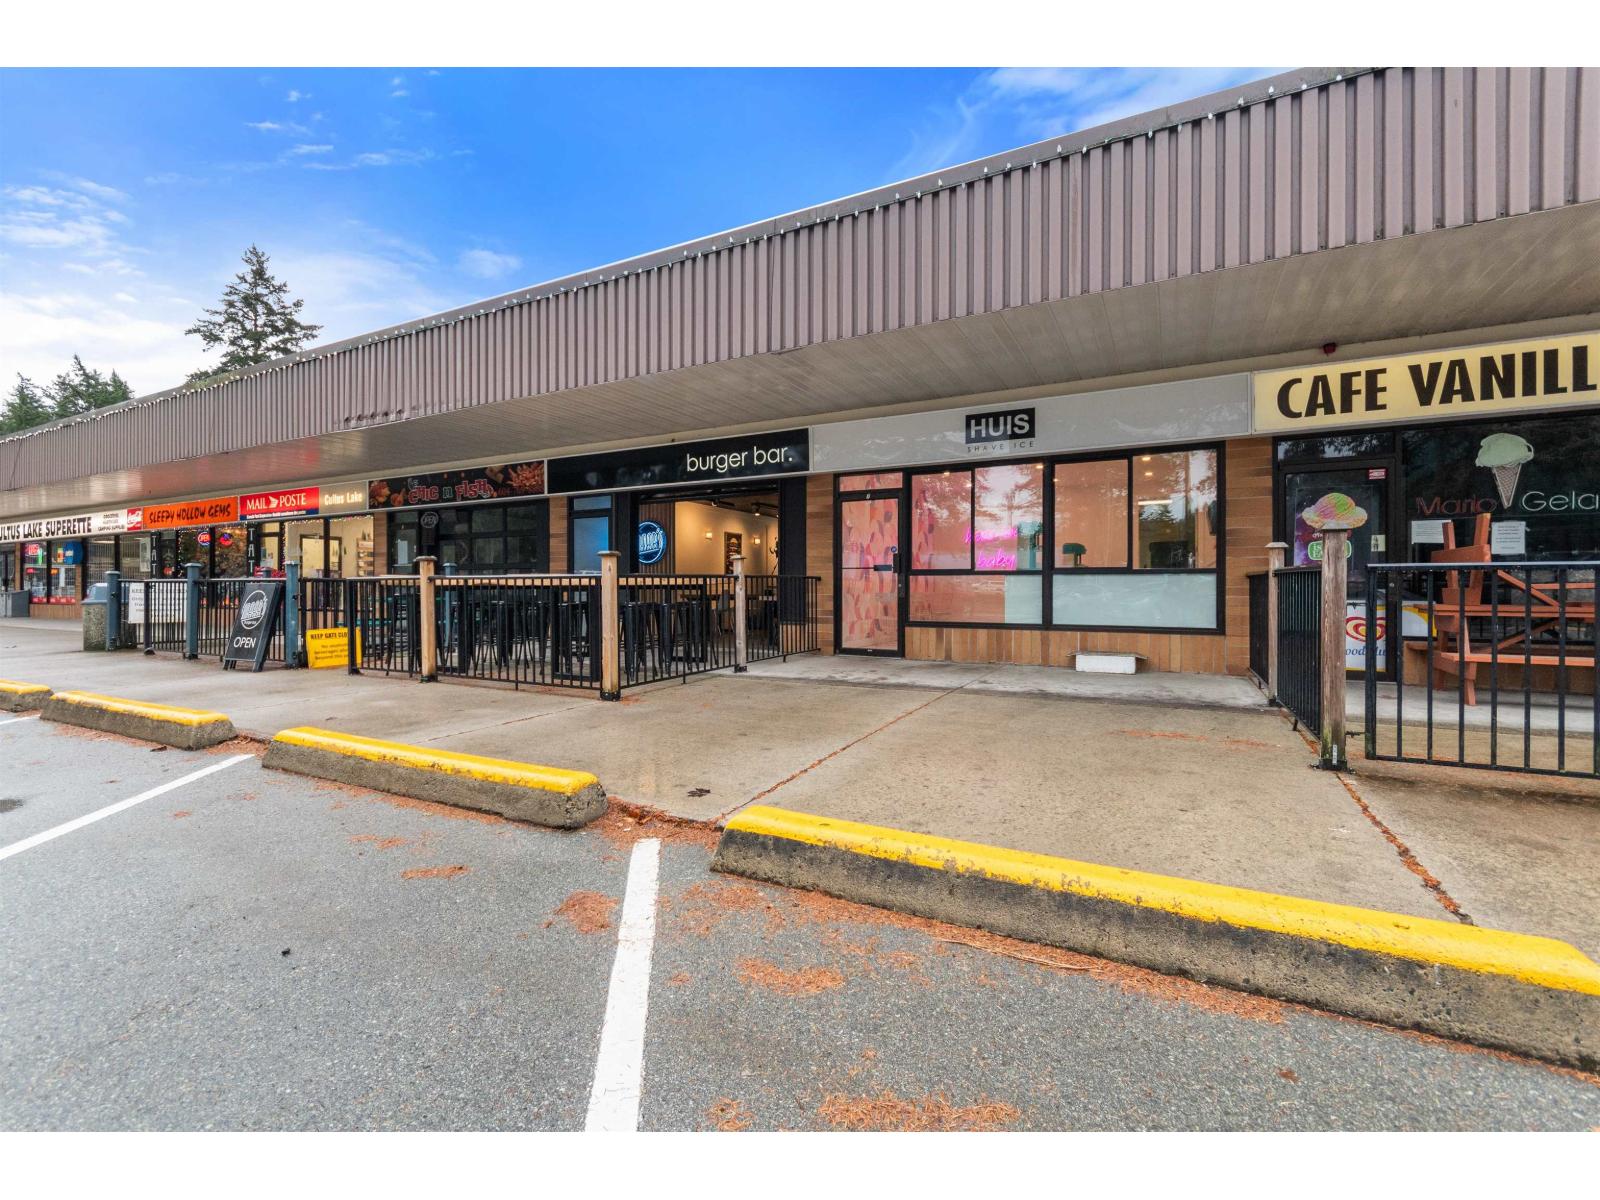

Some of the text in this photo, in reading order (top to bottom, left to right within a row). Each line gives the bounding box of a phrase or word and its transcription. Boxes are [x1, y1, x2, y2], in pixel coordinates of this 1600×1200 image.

[1277, 345, 1598, 418] CAFE VANILL
[970, 414, 1030, 439] HUIS
[967, 440, 1035, 453] SHAVE ICE
[686, 446, 793, 473] burger bar.
[246, 492, 307, 511] MAIL POSTE
[346, 491, 363, 503] Lake
[1417, 495, 1498, 514] Mario
[149, 510, 174, 524] SLEEPY
[176, 506, 206, 520] HOLLOW
[208, 503, 231, 518] GEMS
[23, 522, 42, 539] LAKE
[45, 516, 92, 537] SUPERETTE
[233, 636, 257, 648] OPEN
